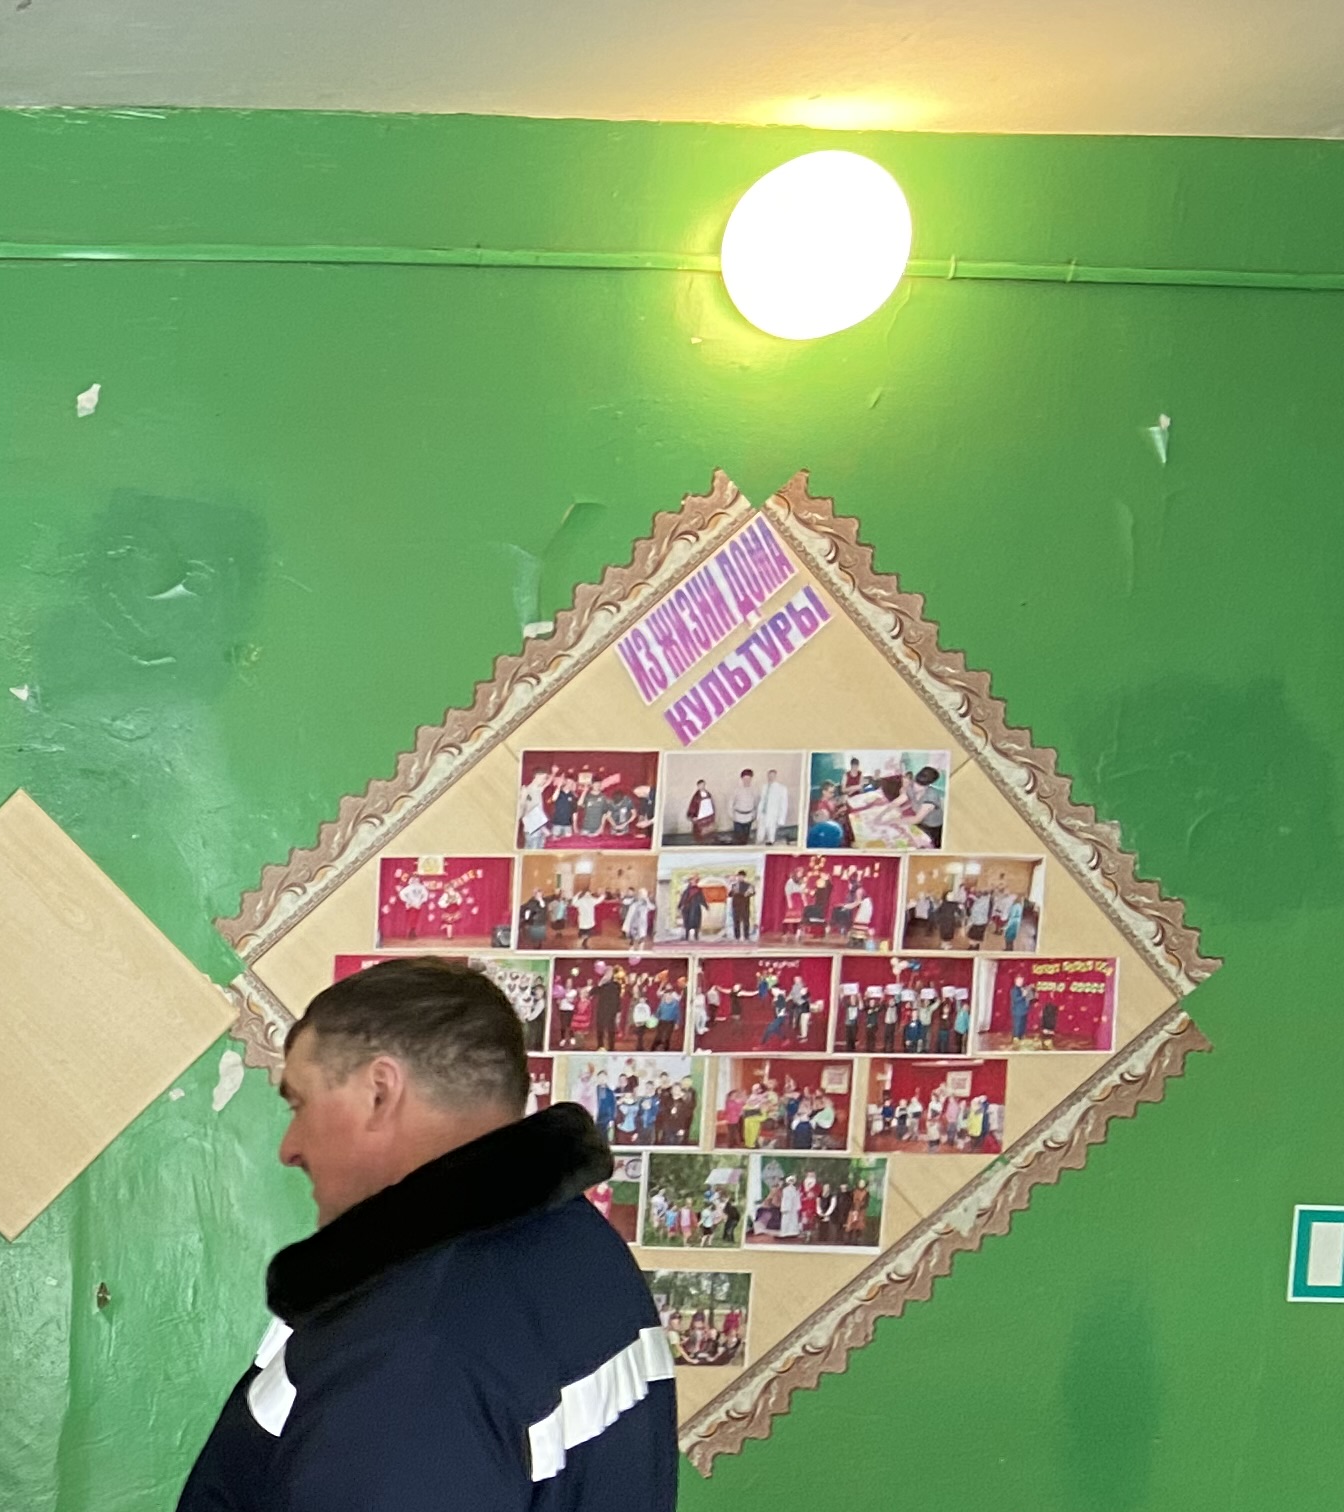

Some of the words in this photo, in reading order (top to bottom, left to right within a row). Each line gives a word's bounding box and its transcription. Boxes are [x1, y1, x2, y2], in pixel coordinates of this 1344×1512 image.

[618, 628, 668, 703] ИЗ
[644, 565, 737, 679] ЖИЗНИ
[714, 515, 795, 626] ДОМА
[663, 584, 832, 747] КУЛЬТУРЫ
